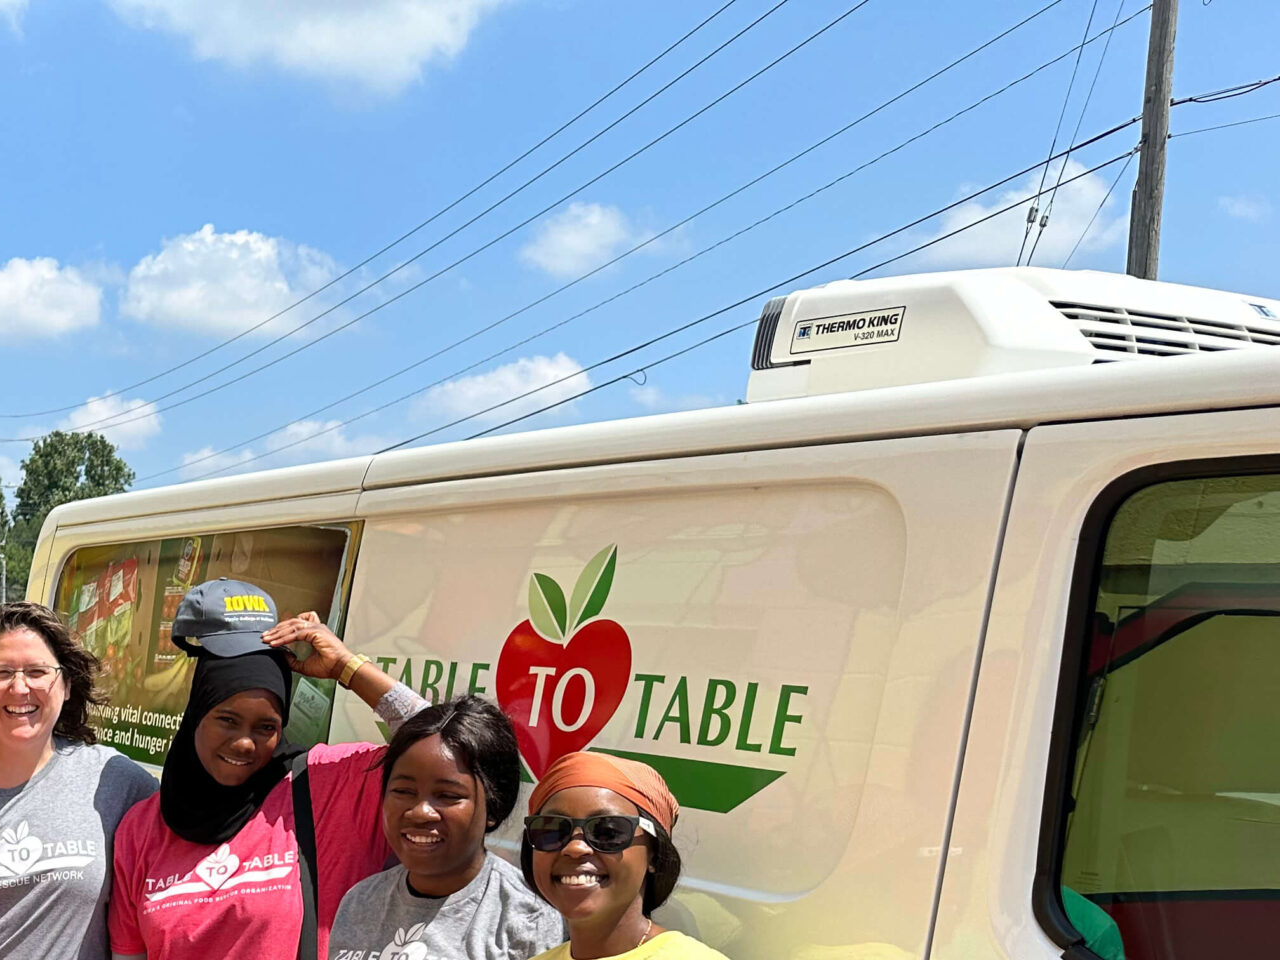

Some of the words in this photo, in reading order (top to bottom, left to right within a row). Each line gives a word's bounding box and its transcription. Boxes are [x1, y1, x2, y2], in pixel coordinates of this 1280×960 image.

[816, 318, 865, 335] THERMO
[868, 313, 899, 329] KING
[854, 331, 874, 341] V-320
[876, 328, 896, 339] MAX
[224, 594, 270, 612] IOWA
[121, 704, 141, 724] vital
[528, 665, 595, 732] TO
[633, 673, 809, 757] TABLE
[94, 725, 113, 742] ance
[114, 728, 132, 746] and
[133, 728, 167, 755] hunger
[8, 847, 30, 863] TO
[43, 840, 96, 858] TABLE
[206, 866, 228, 879] TO
[242, 850, 294, 872] TABLE
[33, 870, 84, 886] NETWORK
